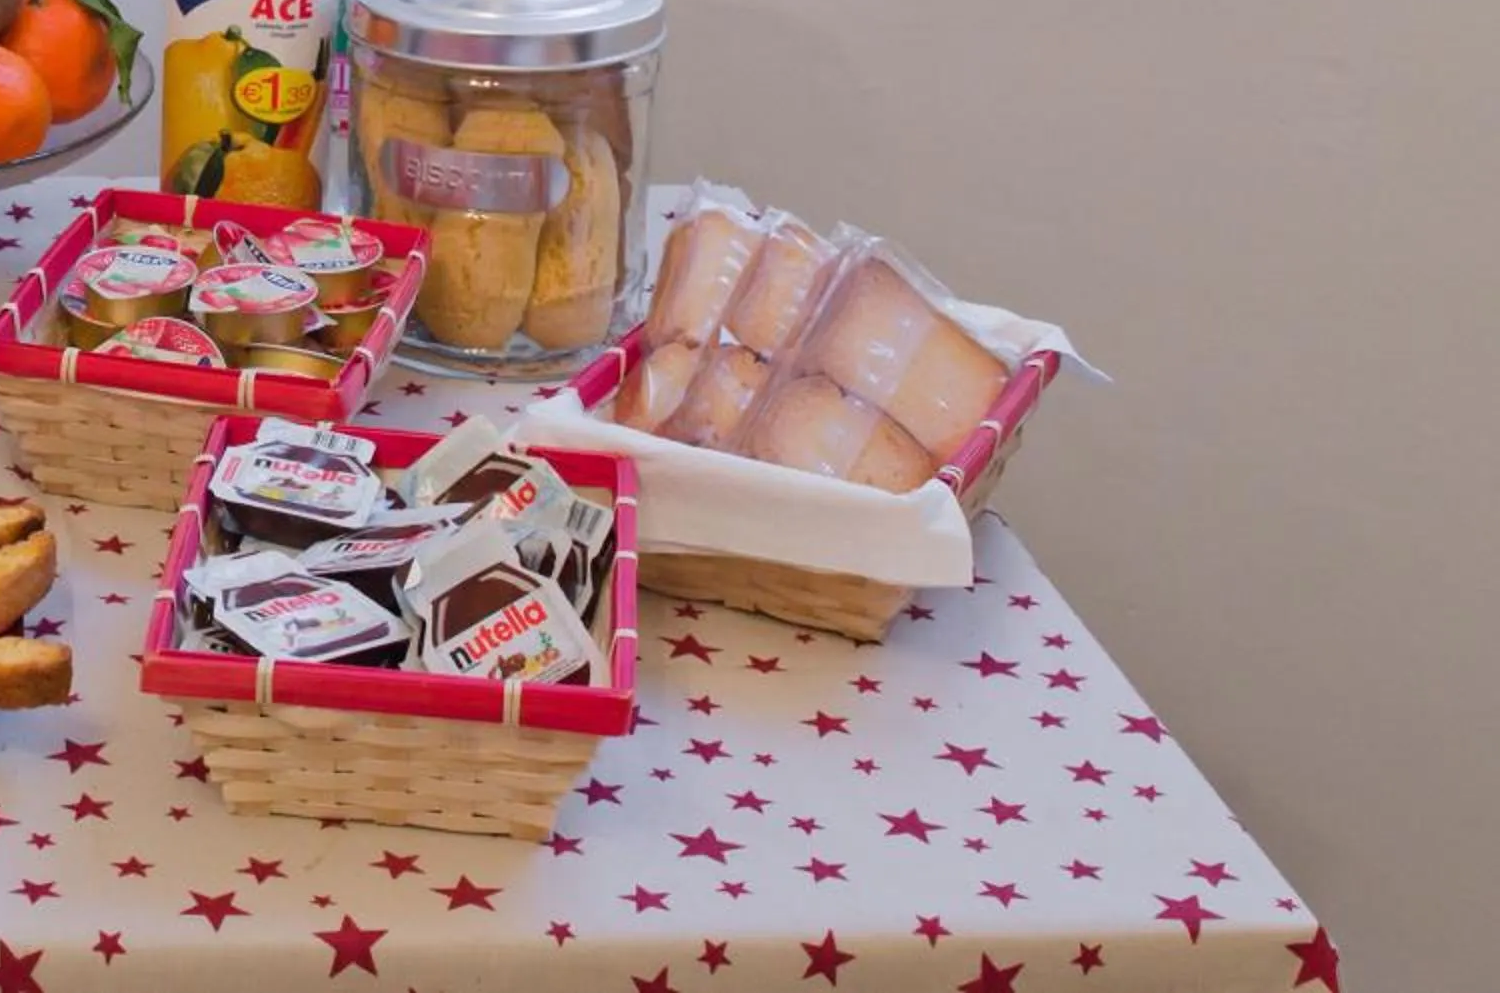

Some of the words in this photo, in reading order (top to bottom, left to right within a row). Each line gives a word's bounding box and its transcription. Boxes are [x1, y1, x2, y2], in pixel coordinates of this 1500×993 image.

[253, 458, 358, 486] nutella
[243, 591, 342, 622] nutella
[449, 600, 548, 670] nutella
